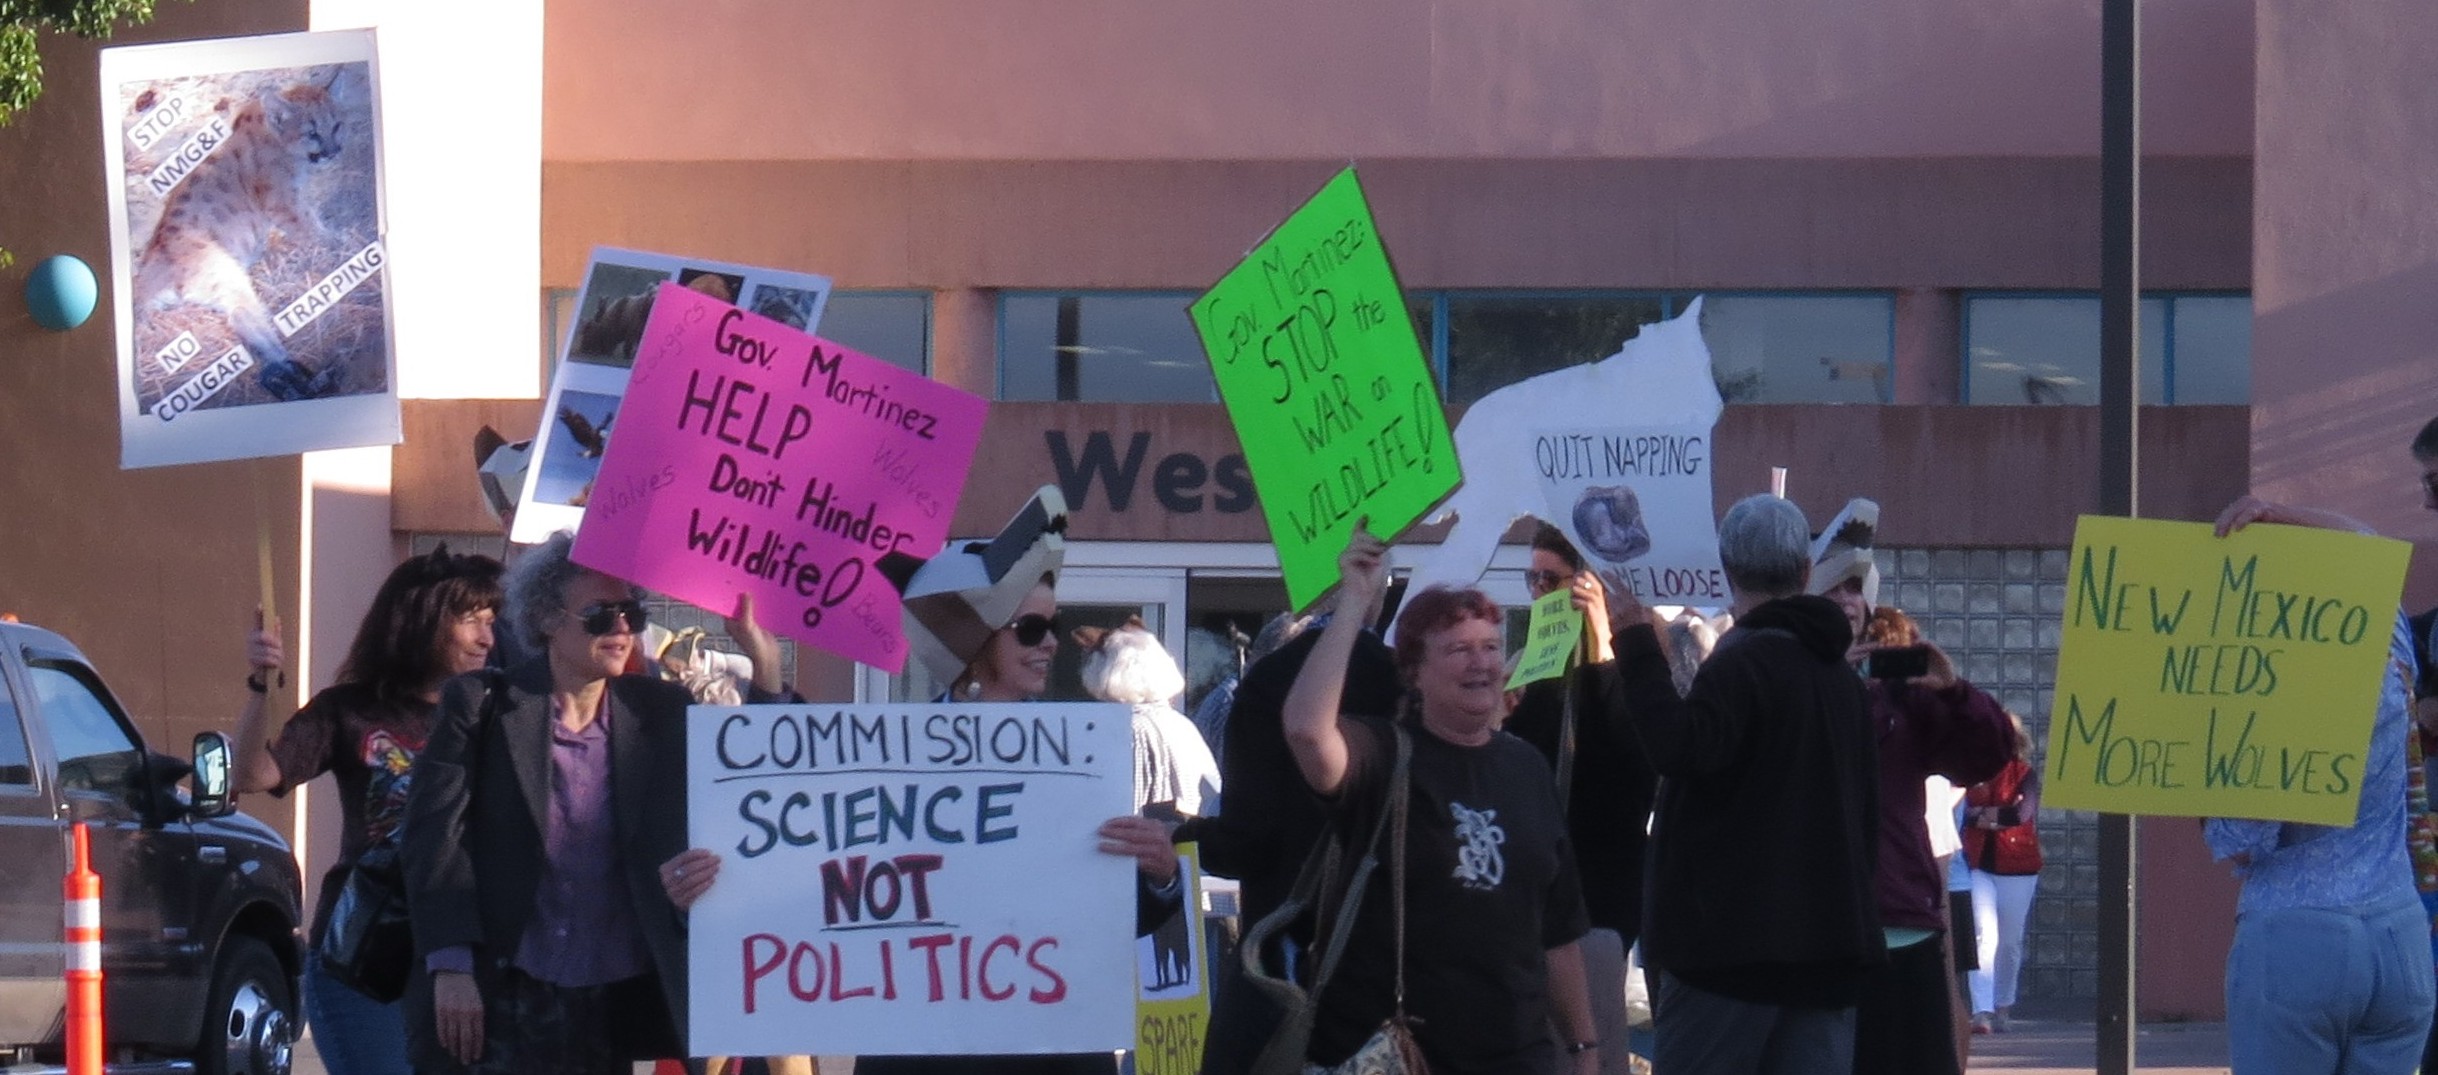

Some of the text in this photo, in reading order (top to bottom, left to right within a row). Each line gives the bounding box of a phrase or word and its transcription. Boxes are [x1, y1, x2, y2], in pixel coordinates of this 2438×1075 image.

[134, 97, 184, 148] STOP
[150, 122, 226, 196] NMG&F
[277, 245, 384, 333] TRAPPING
[1208, 219, 1365, 364] Gov. Martinez:
[160, 335, 196, 371] NO
[715, 309, 937, 440] Gov. Martinez
[1262, 289, 1386, 404] STOP the
[157, 351, 248, 422] COUGAR
[677, 369, 812, 459] HELP
[1293, 374, 1392, 454] WAR on
[1288, 382, 1433, 544] WILDLIFE!
[1536, 434, 1702, 483] QUIT NAPPING
[797, 477, 914, 552] Hinder
[686, 508, 864, 629] Wildlife!
[1649, 566, 1724, 599] LOOSE
[2075, 545, 2369, 645] NEW MEXICO
[2161, 645, 2285, 696] NEEDS
[717, 711, 1096, 770] COMMISSION:
[2058, 693, 2355, 795] MORE WOLVES
[736, 781, 1024, 858] SCIENCE
[819, 854, 944, 925] NOT
[742, 932, 1067, 1014] POLITICS
[1141, 1012, 1201, 1075] SPARE
